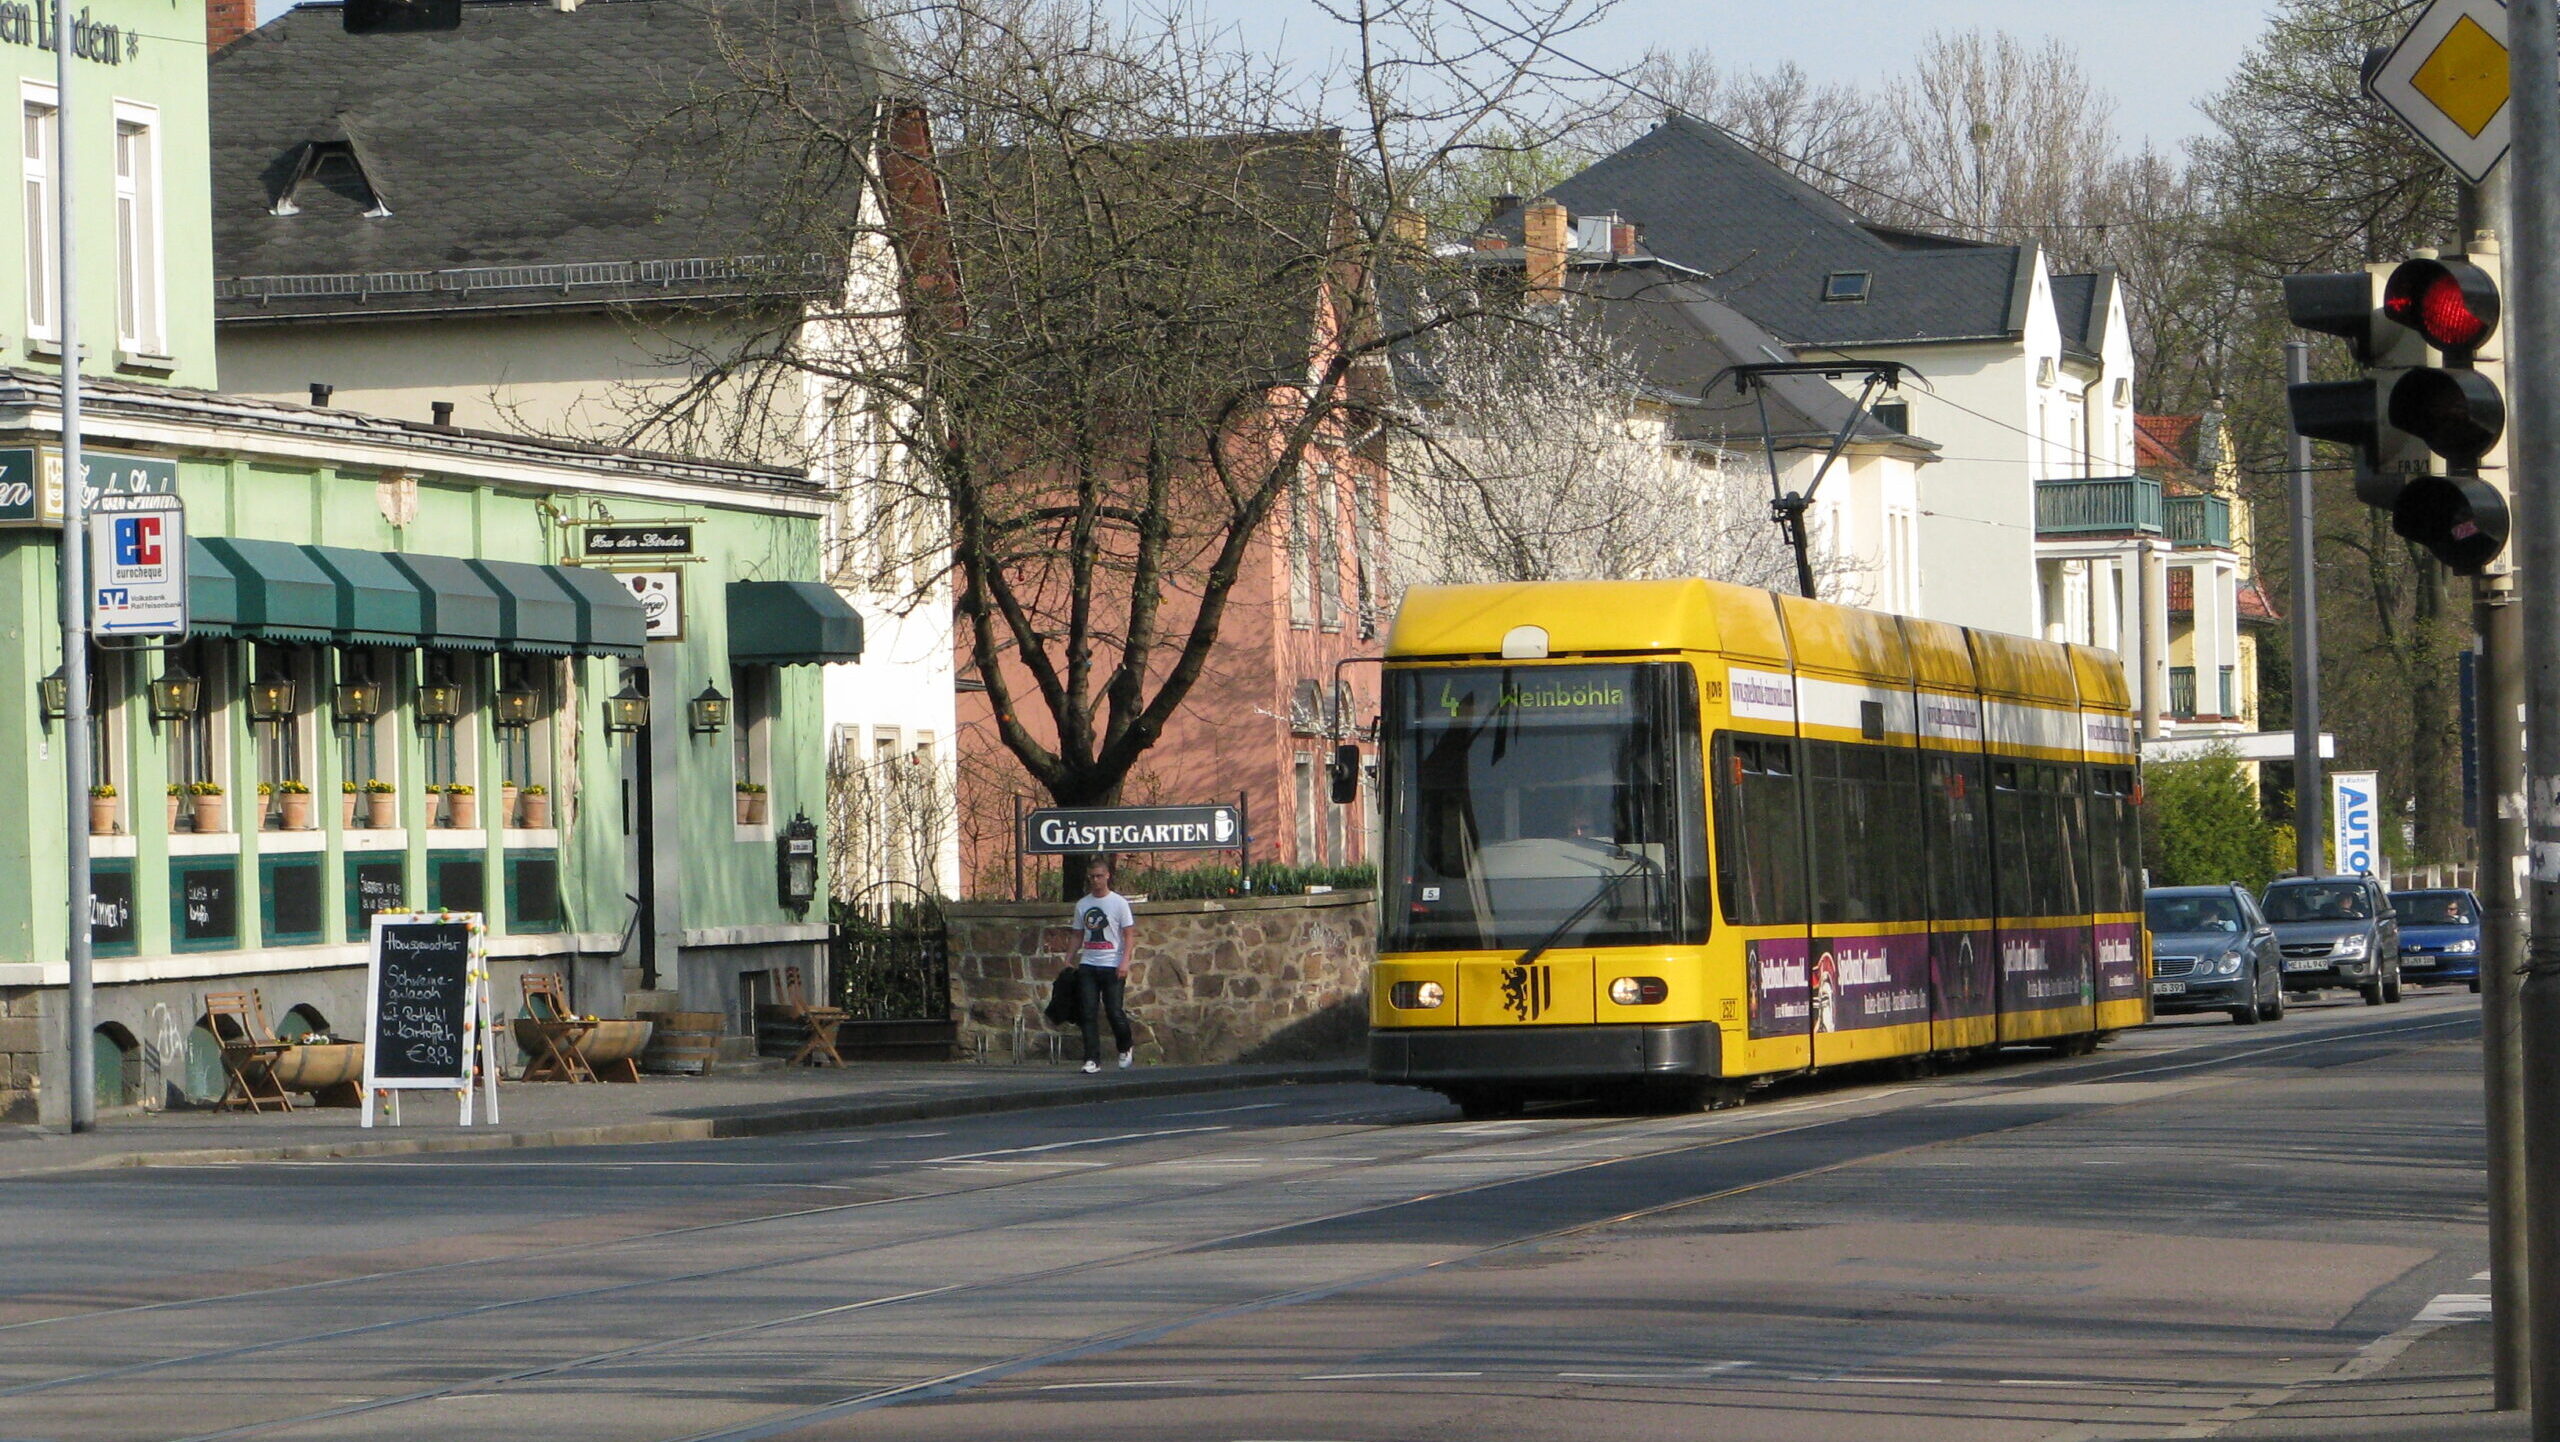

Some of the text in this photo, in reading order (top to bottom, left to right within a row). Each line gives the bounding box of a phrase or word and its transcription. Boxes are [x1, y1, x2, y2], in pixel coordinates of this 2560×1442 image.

[0, 1, 33, 46] en
[0, 465, 32, 507] en
[616, 535, 638, 547] den
[639, 533, 686, 547] Linden
[116, 566, 162, 580] eurocheque
[130, 594, 166, 602] Volksbank
[131, 602, 183, 610] Raiffeisenbank
[1440, 679, 1624, 717] 4 Weinböhla
[2339, 786, 2370, 873] AUTO
[90, 893, 119, 928] ZIMMER
[385, 964, 453, 988] Schweine-
[386, 987, 441, 1006] gulasch
[2169, 983, 2185, 992] 391
[402, 1006, 446, 1021] Rotkohl
[398, 1021, 456, 1044] Kartoffeln
